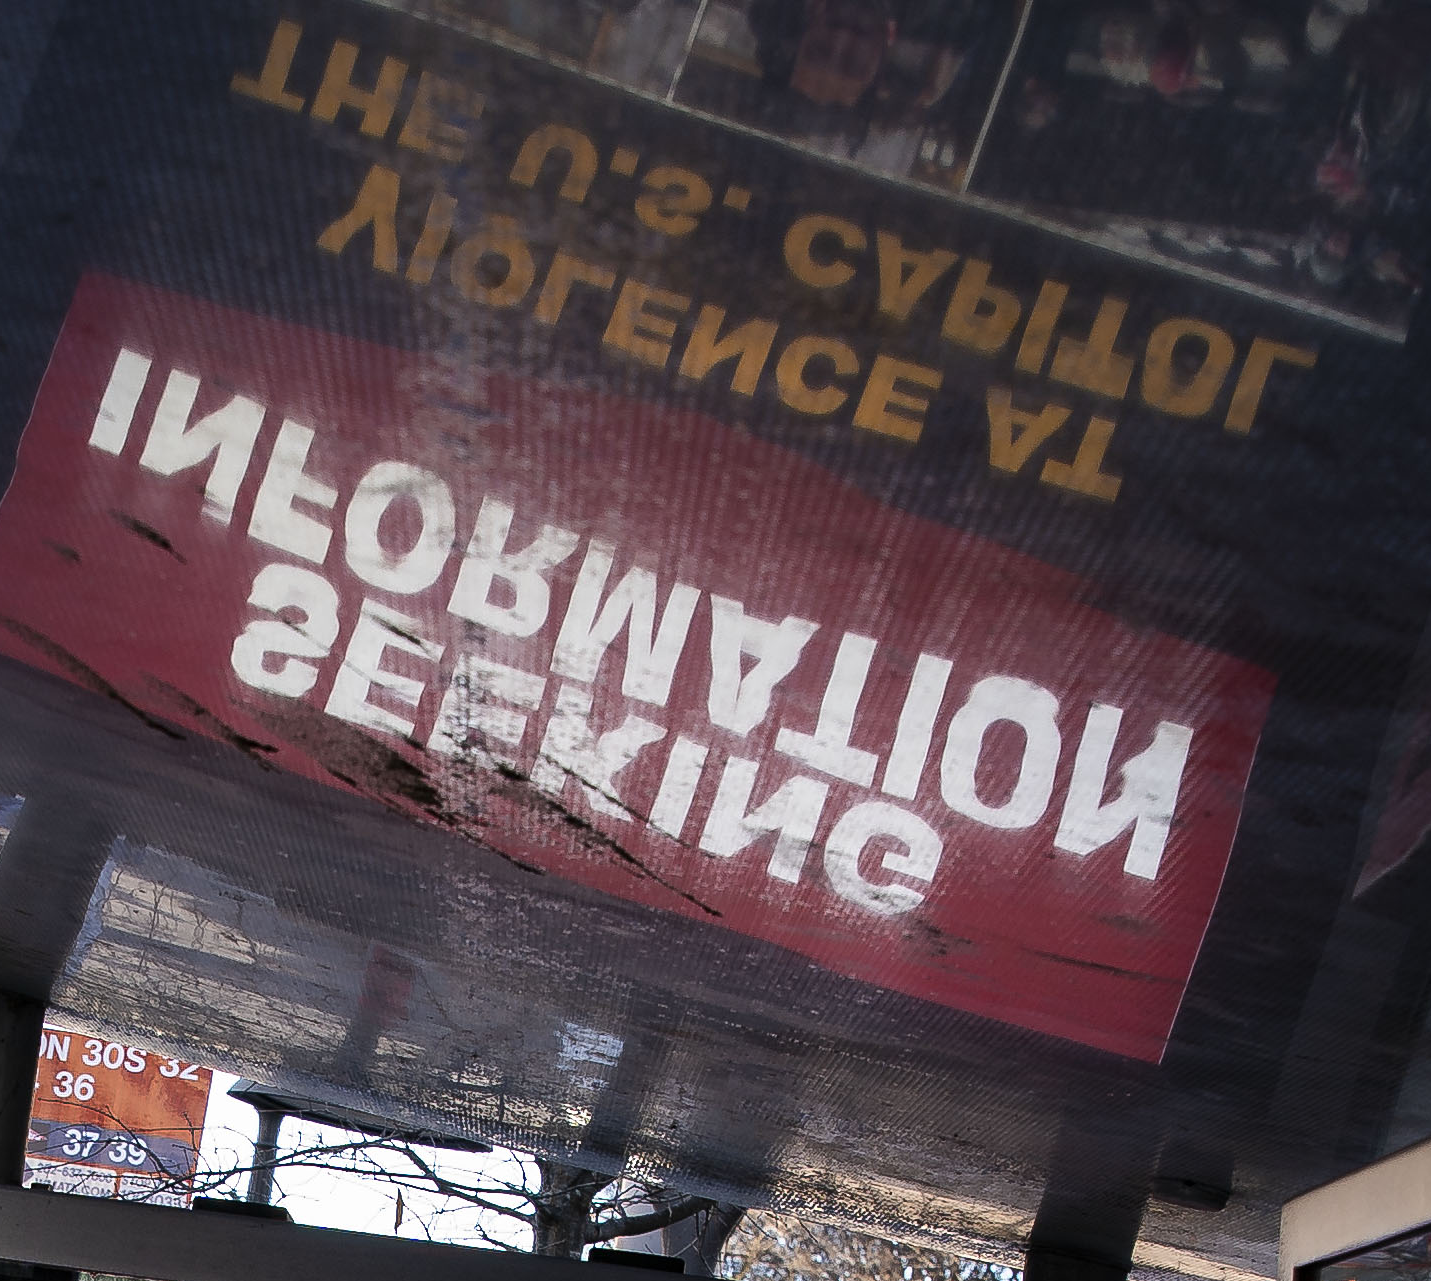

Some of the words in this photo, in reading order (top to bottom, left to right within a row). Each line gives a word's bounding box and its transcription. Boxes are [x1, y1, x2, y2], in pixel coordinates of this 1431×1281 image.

[81, 1039, 148, 1073] 30S
[53, 1070, 96, 1101] 36
[61, 1128, 101, 1158] 37
[107, 1135, 148, 1167] 39
